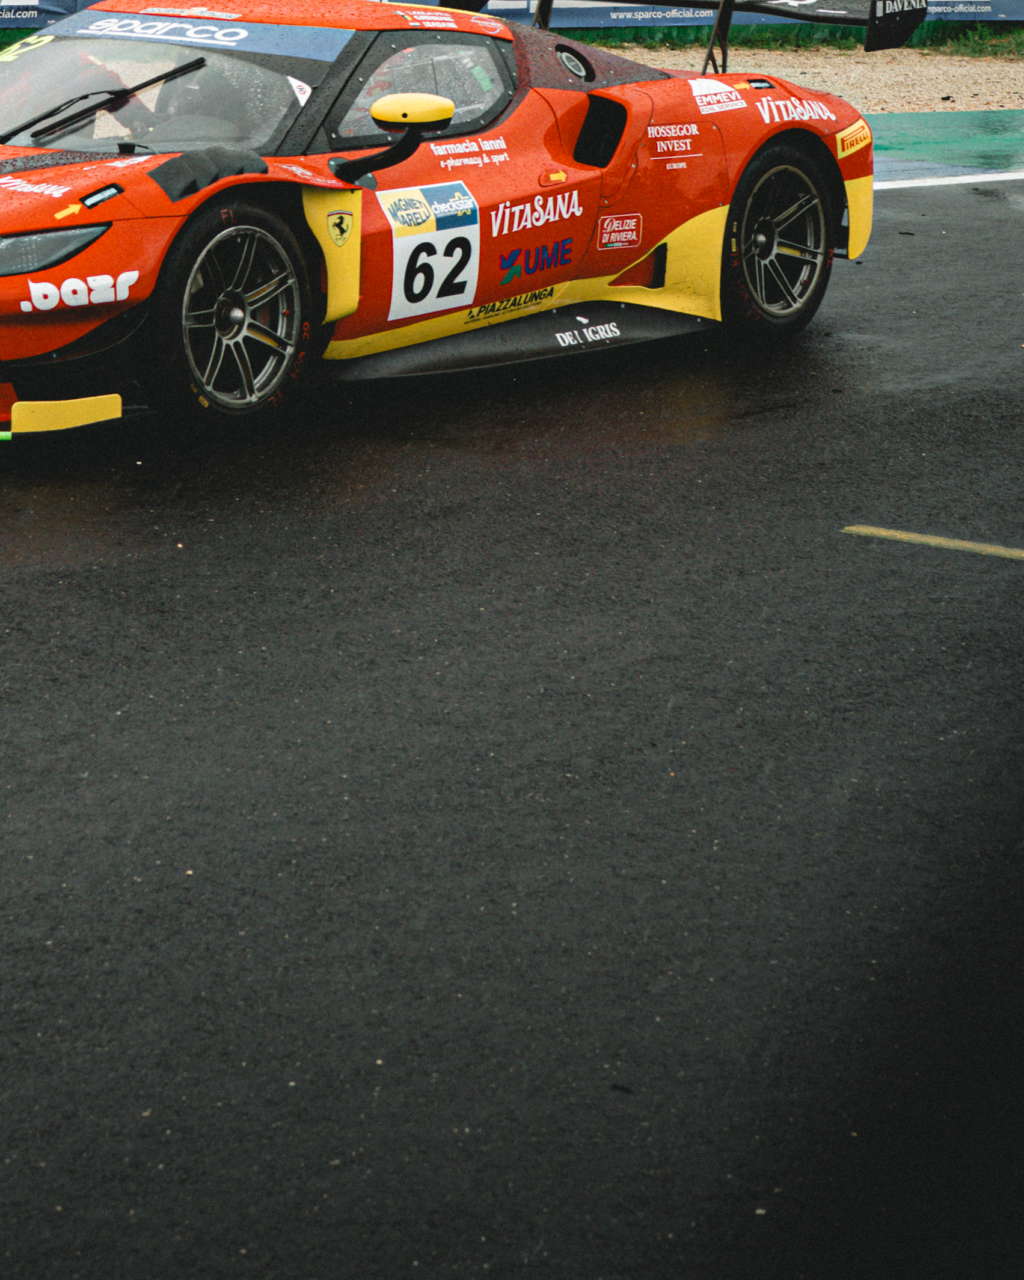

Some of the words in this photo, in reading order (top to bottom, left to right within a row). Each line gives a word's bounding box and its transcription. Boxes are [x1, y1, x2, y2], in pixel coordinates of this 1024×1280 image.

[610, 9, 713, 20] www.sparco-official.com
[927, 3, 991, 15] .sparco-official.com
[88, 18, 249, 41] sparco
[695, 91, 741, 106] EMMEVI
[647, 124, 700, 138] HOSSEGOR
[841, 125, 869, 152] PIRELLI
[430, 139, 480, 156] farmacia
[478, 136, 507, 151] ianni
[656, 139, 693, 153] INVEST
[440, 157, 483, 171] e-pharmacy
[490, 152, 510, 166] sport
[666, 162, 687, 170] EUROPE
[432, 199, 474, 214] checkstar
[524, 238, 573, 275] UME
[404, 236, 472, 304] 62
[477, 287, 555, 317] PIAZZALUNGA
